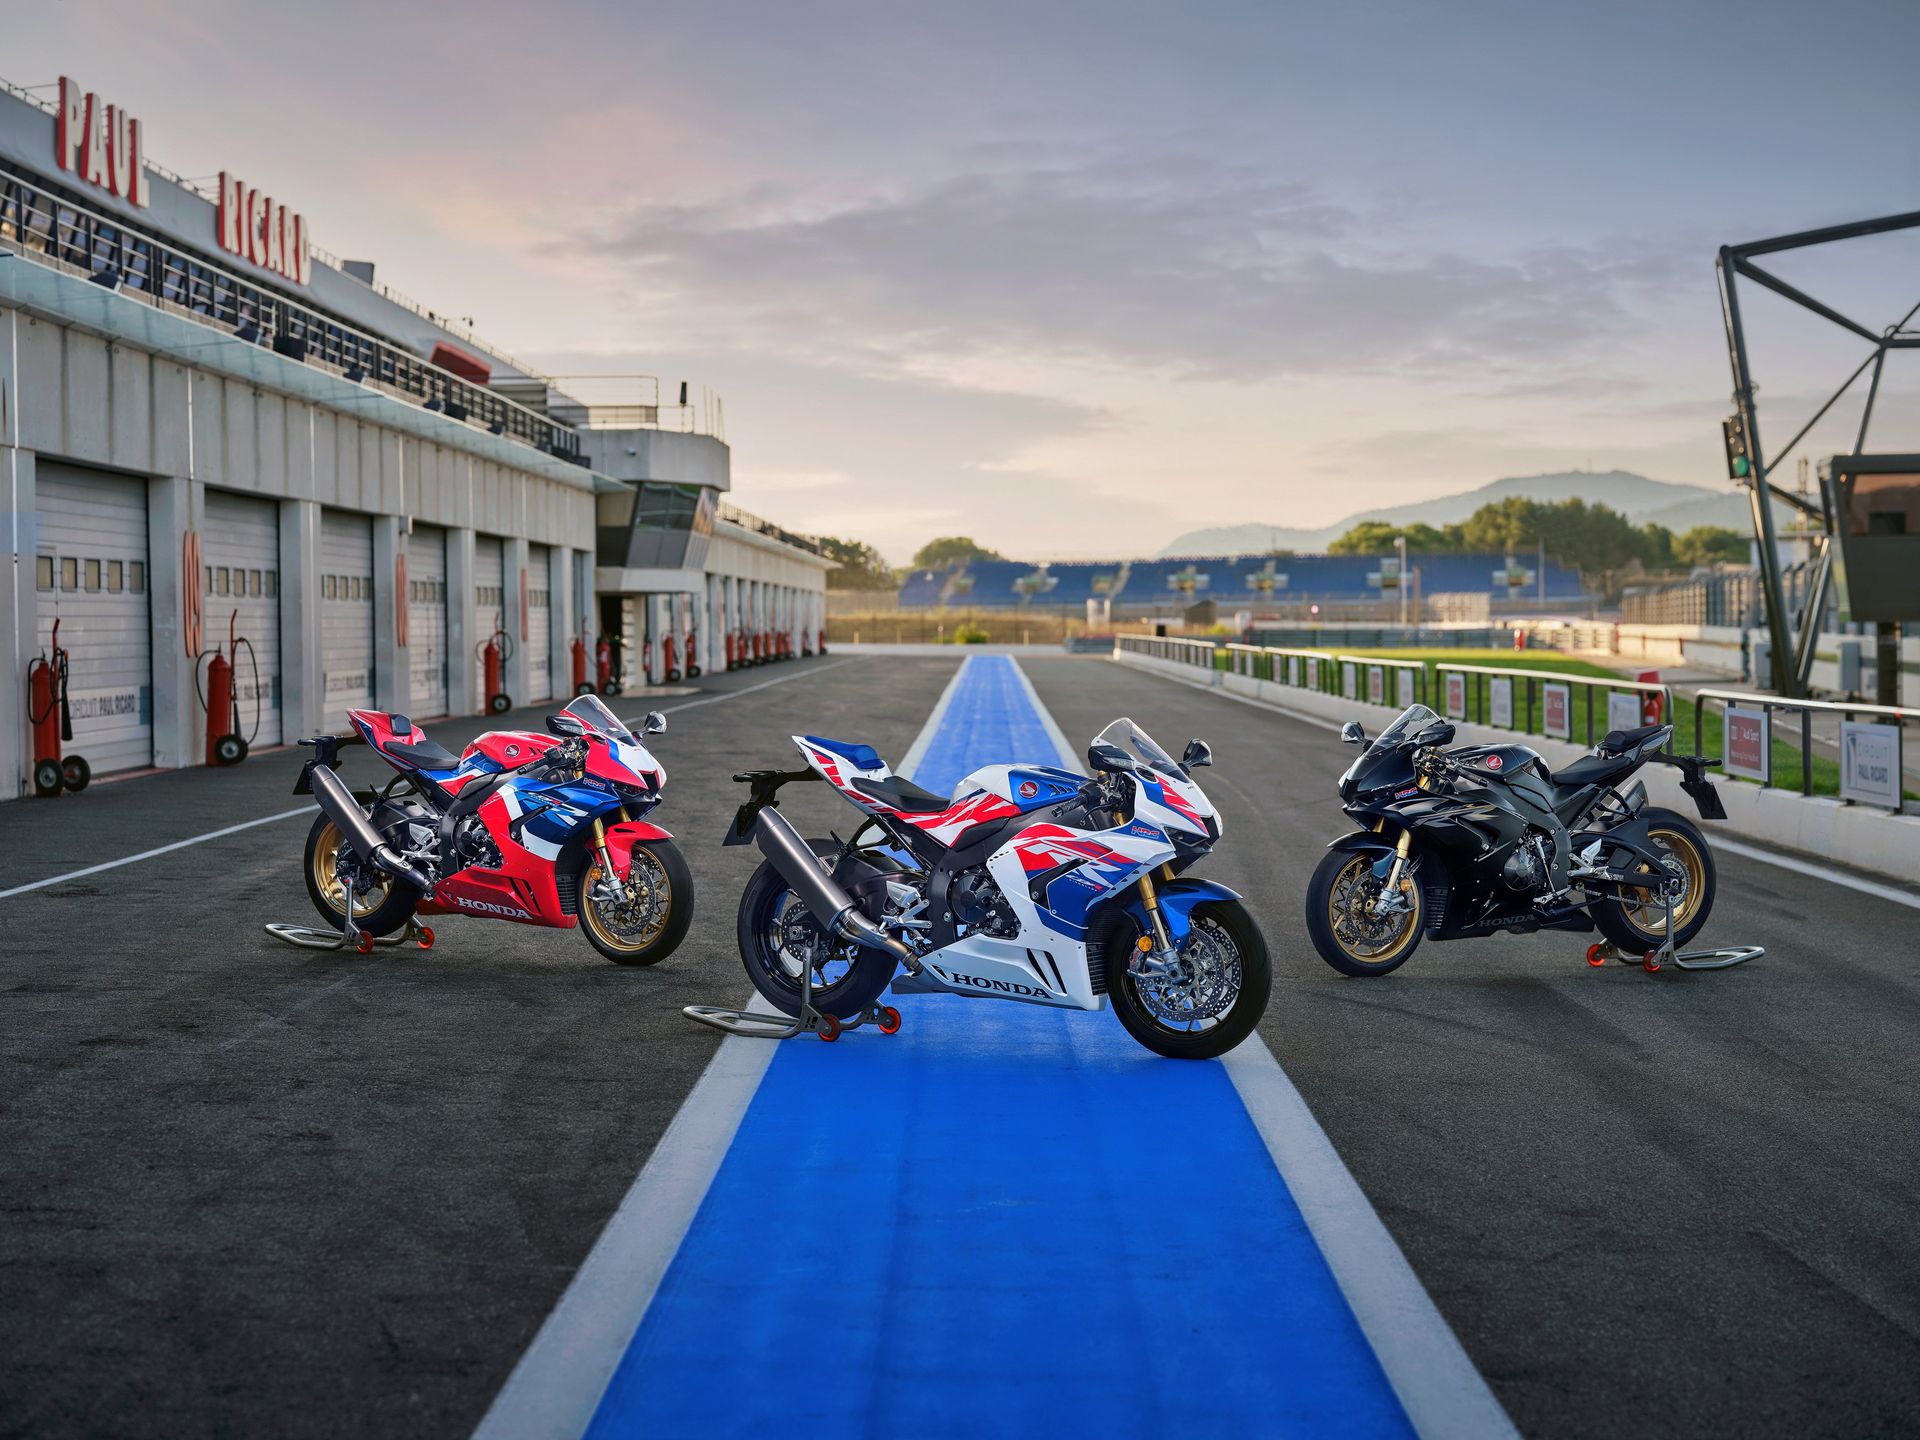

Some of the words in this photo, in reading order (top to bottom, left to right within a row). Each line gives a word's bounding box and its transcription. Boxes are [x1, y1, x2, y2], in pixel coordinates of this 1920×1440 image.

[57, 76, 150, 208] PAUL
[217, 170, 311, 286] RICARD
[1394, 787, 1419, 800] HRC
[1130, 825, 1160, 840] HRC
[456, 896, 533, 920] HONDA
[1478, 914, 1536, 928] HONDA
[951, 972, 1054, 1000] HONDA
